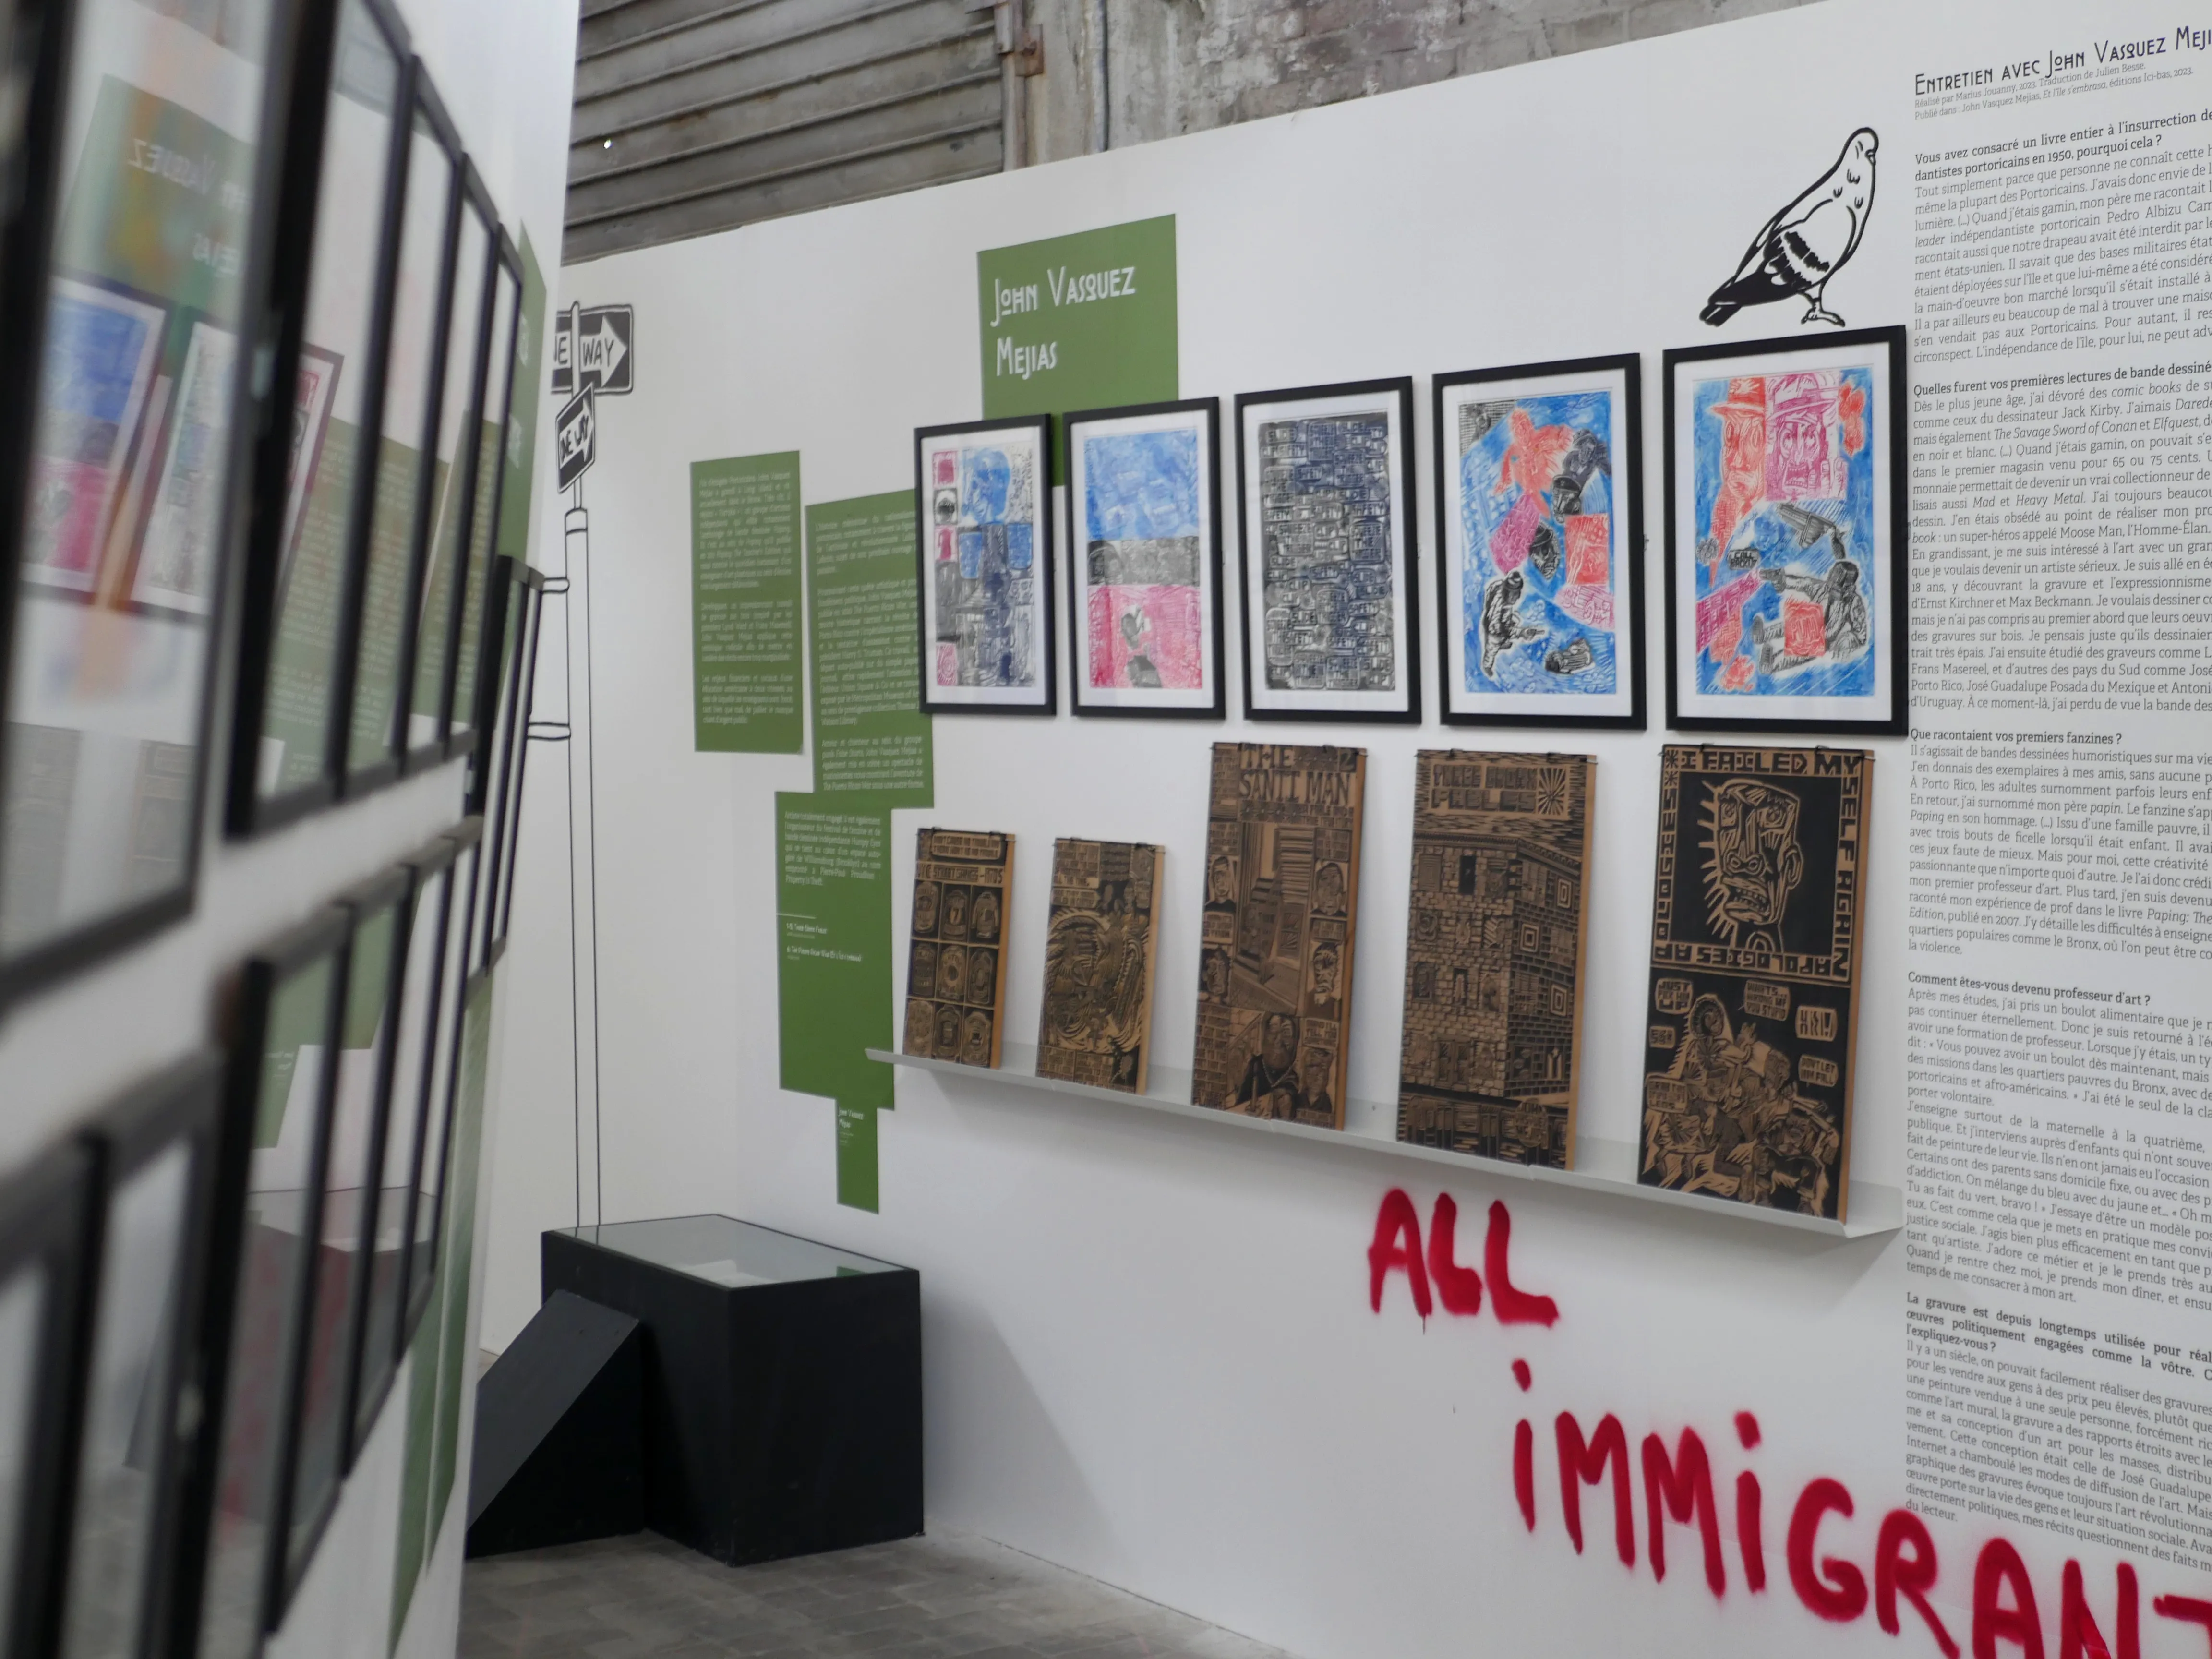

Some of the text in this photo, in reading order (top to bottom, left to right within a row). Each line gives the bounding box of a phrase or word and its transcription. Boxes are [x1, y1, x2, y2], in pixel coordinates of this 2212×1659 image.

[1915, 68, 1993, 96] ENTRETIEN
[2001, 60, 2040, 81] AVEC
[2049, 51, 2084, 77] JOHN
[2094, 37, 2166, 63] VASQUEZ
[1915, 153, 1941, 165] Vous
[1944, 149, 1968, 160] avez
[1972, 138, 2019, 156] consacré
[2022, 138, 2037, 148] un
[2041, 134, 2066, 146] livre
[2069, 128, 2104, 141] entier
[2107, 124, 2114, 136] à
[2118, 114, 2197, 133] l'insurrection
[1915, 167, 1962, 181] dantistes
[1964, 156, 2030, 177] portoricains
[2032, 154, 2045, 164] en
[2047, 149, 2074, 162] 1950,
[2076, 142, 2128, 161] pourquoi
[583, 338, 615, 368] WAY
[1913, 360, 2212, 398] Quelles furent vos premières lectures de bande dessiné
[1911, 594, 2201, 609] d'Ernst Kirchner et Max Beckmann. Je voulais dessiner
[1911, 729, 1931, 742] Que
[1933, 730, 1993, 741] racontaient
[1995, 733, 2014, 742] vos
[2016, 731, 2064, 745] premiers
[1908, 971, 1957, 986] Comment
[1959, 976, 2009, 992] êtes-vous
[2011, 981, 2051, 996] devenu
[2053, 987, 2113, 1002] professeur
[1907, 1086, 1994, 1106] porter volontaire.
[1368, 1188, 1559, 1329] ALL
[1906, 1293, 1919, 1304] La
[1925, 1298, 1966, 1314] gravure
[1972, 1308, 1988, 1319] est
[1996, 1311, 2032, 1327] depuis
[2039, 1319, 2097, 1341] longtemps
[2104, 1334, 2145, 1350] utilisée
[2153, 1343, 2181, 1357] pour
[1906, 1310, 2195, 1377] œuvres politiquement engagées comme la vôtre.
